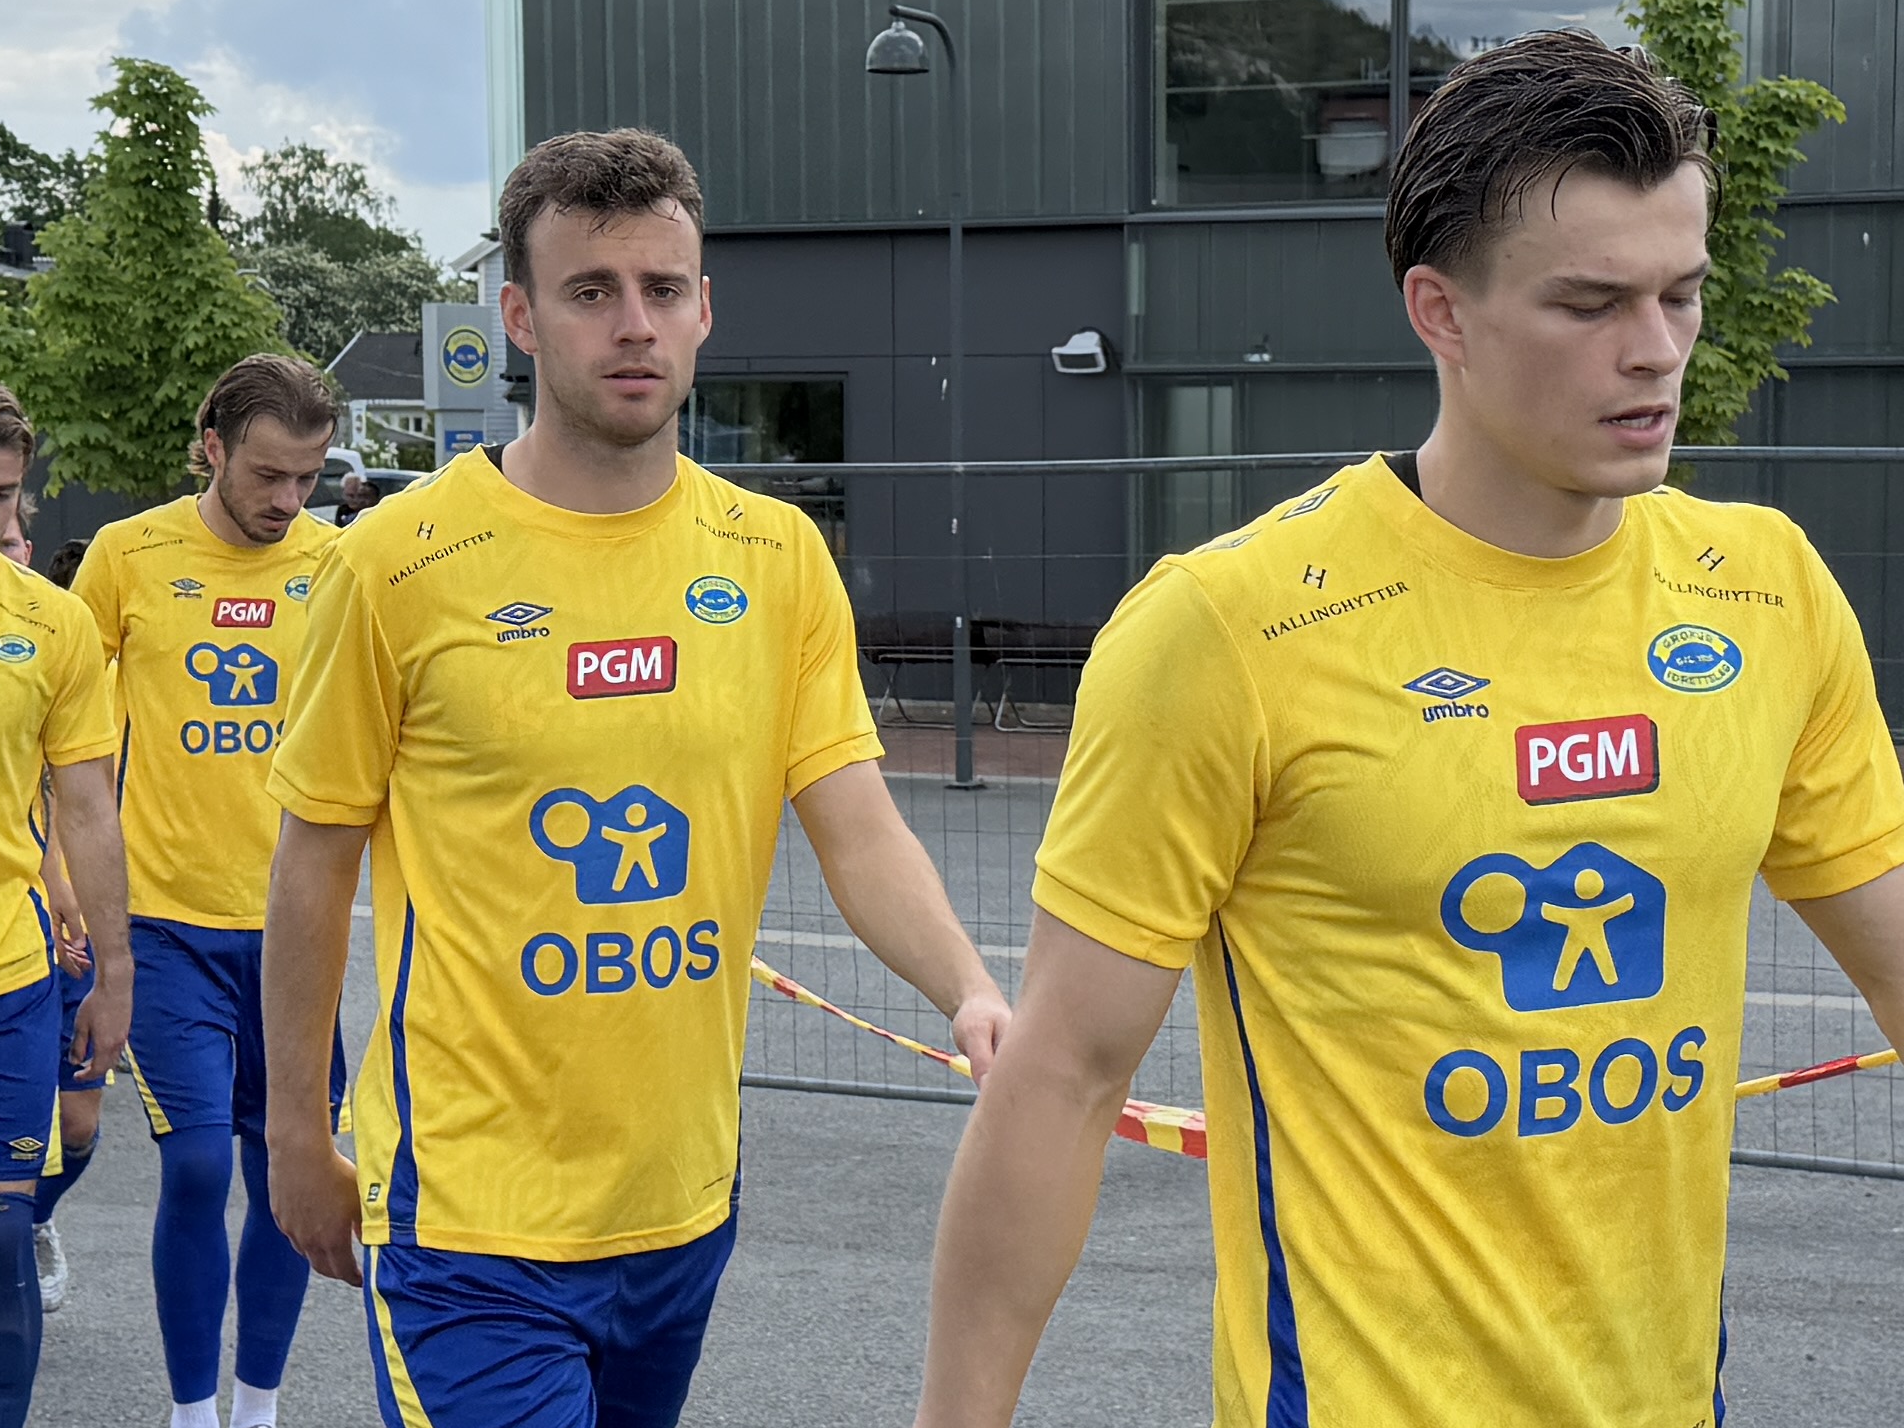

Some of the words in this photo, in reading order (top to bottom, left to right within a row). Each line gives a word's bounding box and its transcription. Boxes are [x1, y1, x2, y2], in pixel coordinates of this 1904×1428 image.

[216, 601, 268, 623] PGM
[496, 625, 551, 643] umbro
[1261, 581, 1411, 641] HALLINGHYTTER
[576, 645, 663, 687] PGM
[1422, 701, 1491, 723] umbro
[1527, 727, 1641, 787] PGM
[519, 918, 721, 997] OBOS
[1423, 1024, 1708, 1138] OBOS
